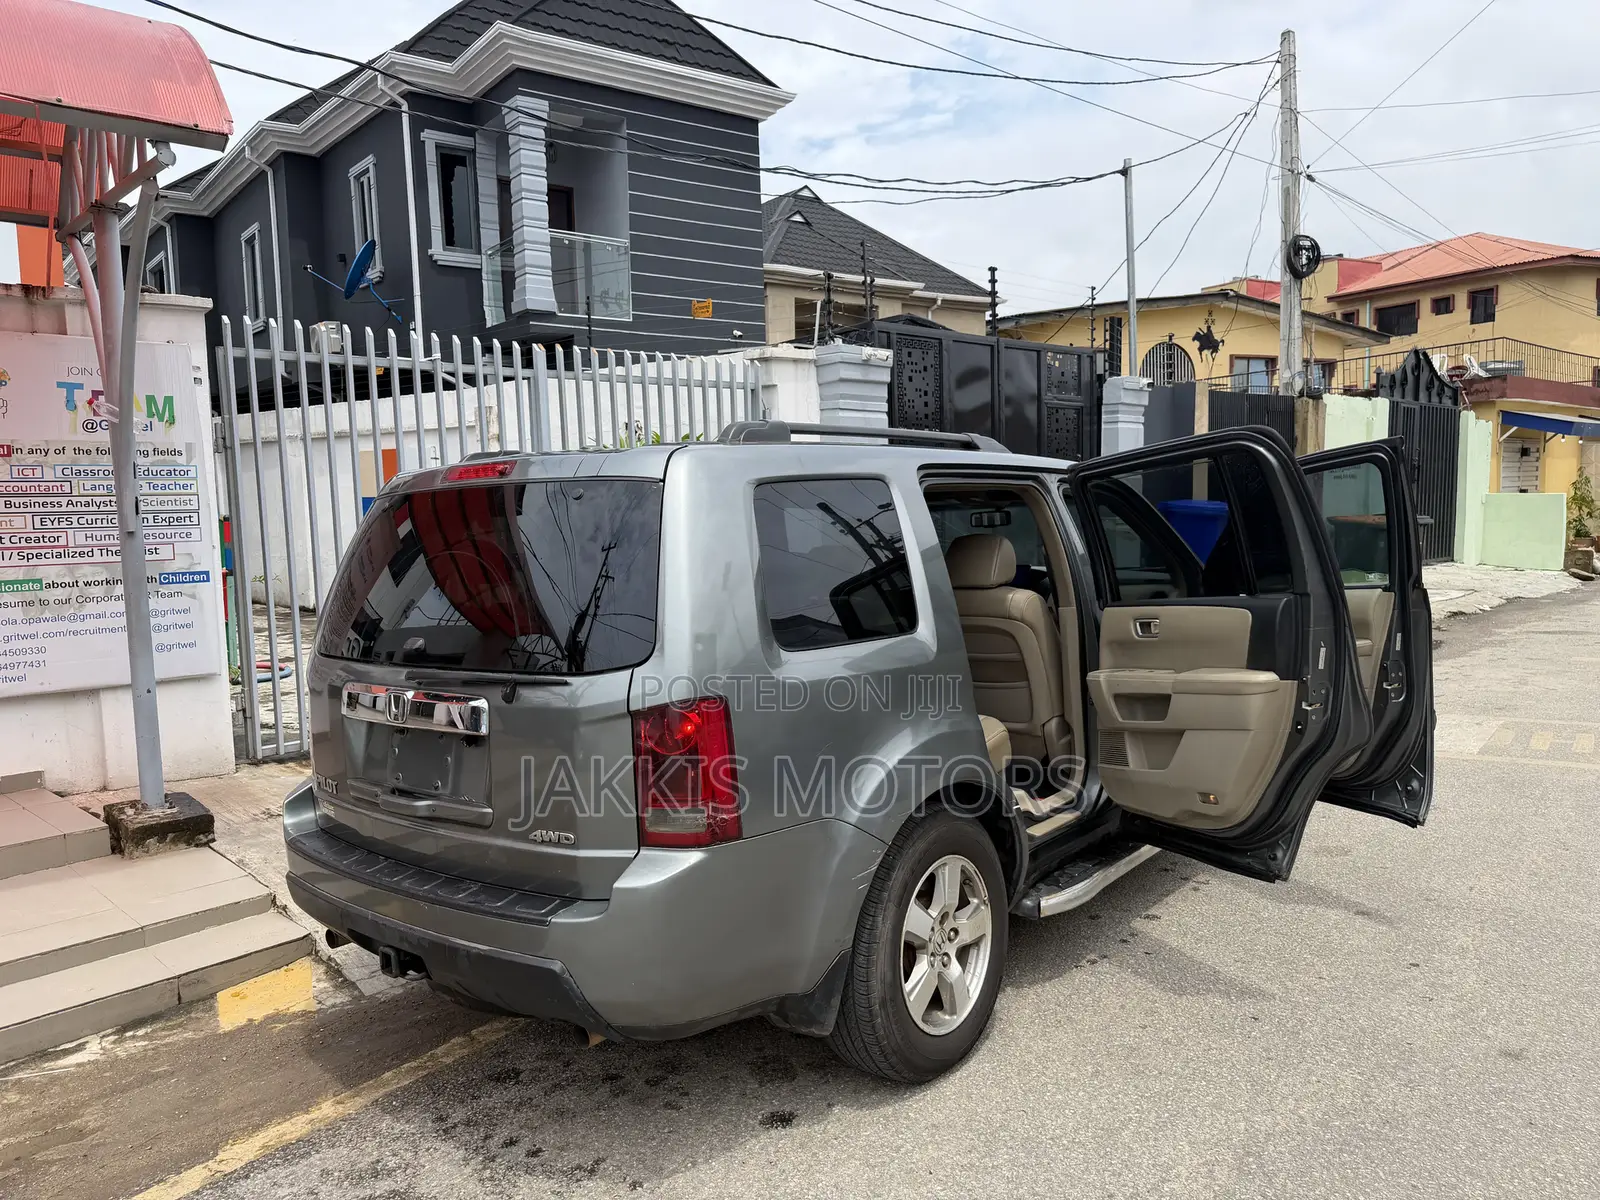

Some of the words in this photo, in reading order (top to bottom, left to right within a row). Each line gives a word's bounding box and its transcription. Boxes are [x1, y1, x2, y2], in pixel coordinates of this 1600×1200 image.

[67, 366, 93, 377] JOIN
[12, 446, 23, 455] in
[27, 448, 50, 457] any
[54, 446, 67, 455] of
[73, 447, 92, 456] the
[152, 448, 183, 457] fields
[17, 468, 37, 476] ICT
[145, 481, 194, 491] Teacher
[4, 499, 63, 509] Business
[40, 516, 73, 527] EYFS
[153, 514, 194, 526] Expert
[9, 533, 62, 545] Creator
[143, 531, 192, 541] esource
[17, 548, 94, 562] Specialized
[44, 580, 79, 590] about
[83, 577, 123, 587] workin
[160, 573, 207, 583] Children
[39, 599, 50, 608] to
[53, 598, 72, 607] our
[75, 592, 124, 605] Corporat
[154, 590, 183, 599] Team
[149, 606, 191, 618] @gritwel
[152, 621, 194, 633] @gritwel
[155, 640, 197, 653] @gritwel
[528, 829, 575, 845] 4WD
